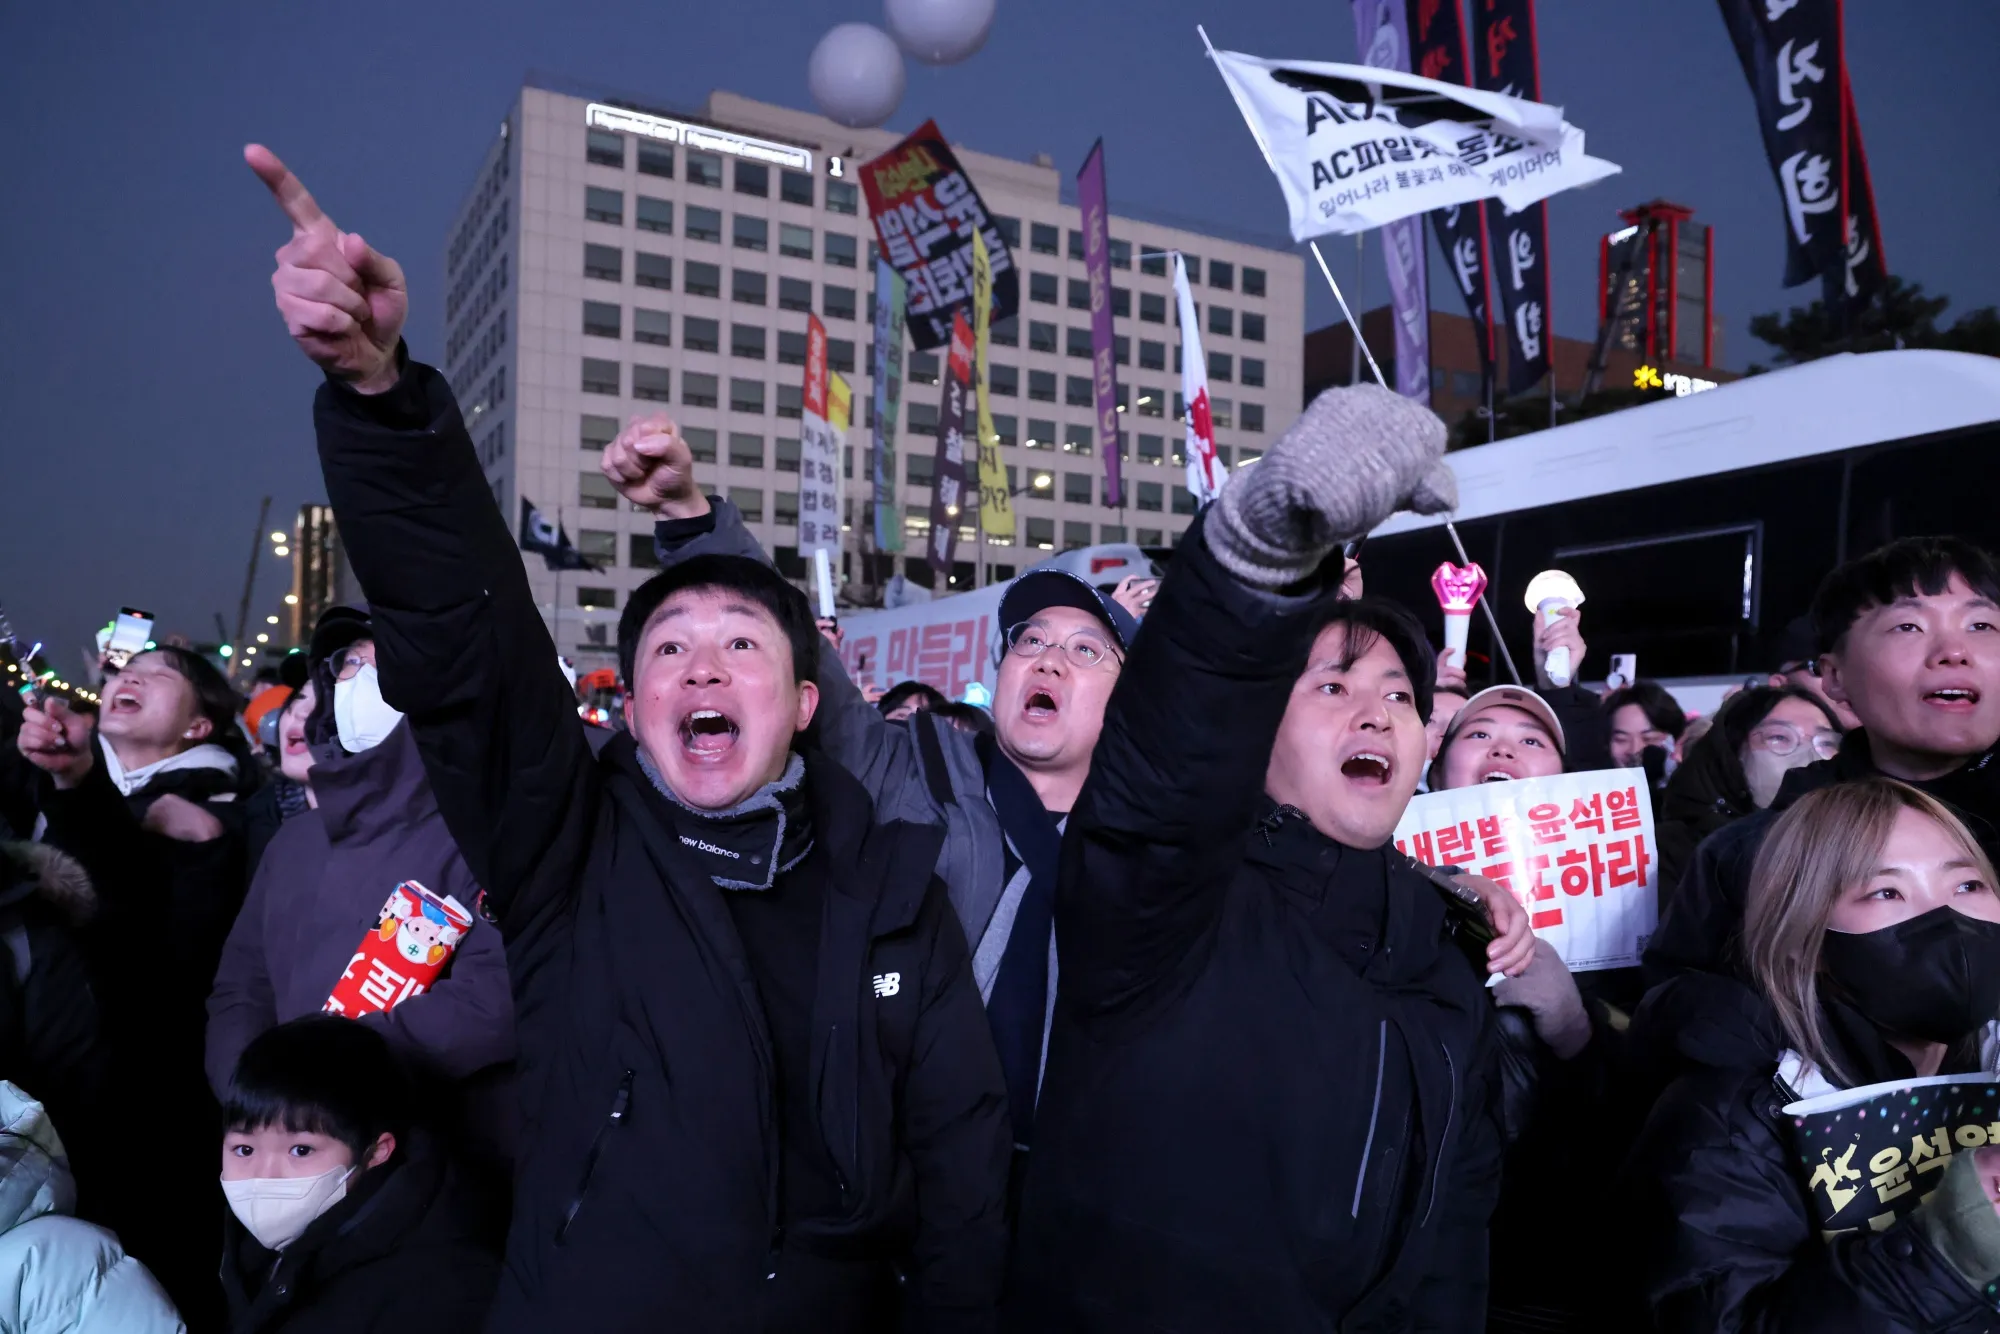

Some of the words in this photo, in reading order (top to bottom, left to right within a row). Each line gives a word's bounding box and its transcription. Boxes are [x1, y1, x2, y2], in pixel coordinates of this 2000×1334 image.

[886, 614, 990, 698] 만들라
[678, 835, 698, 849] new
[698, 839, 740, 860] balance
[1528, 786, 1642, 846] 윤석열
[1463, 834, 1650, 929] 포하라
